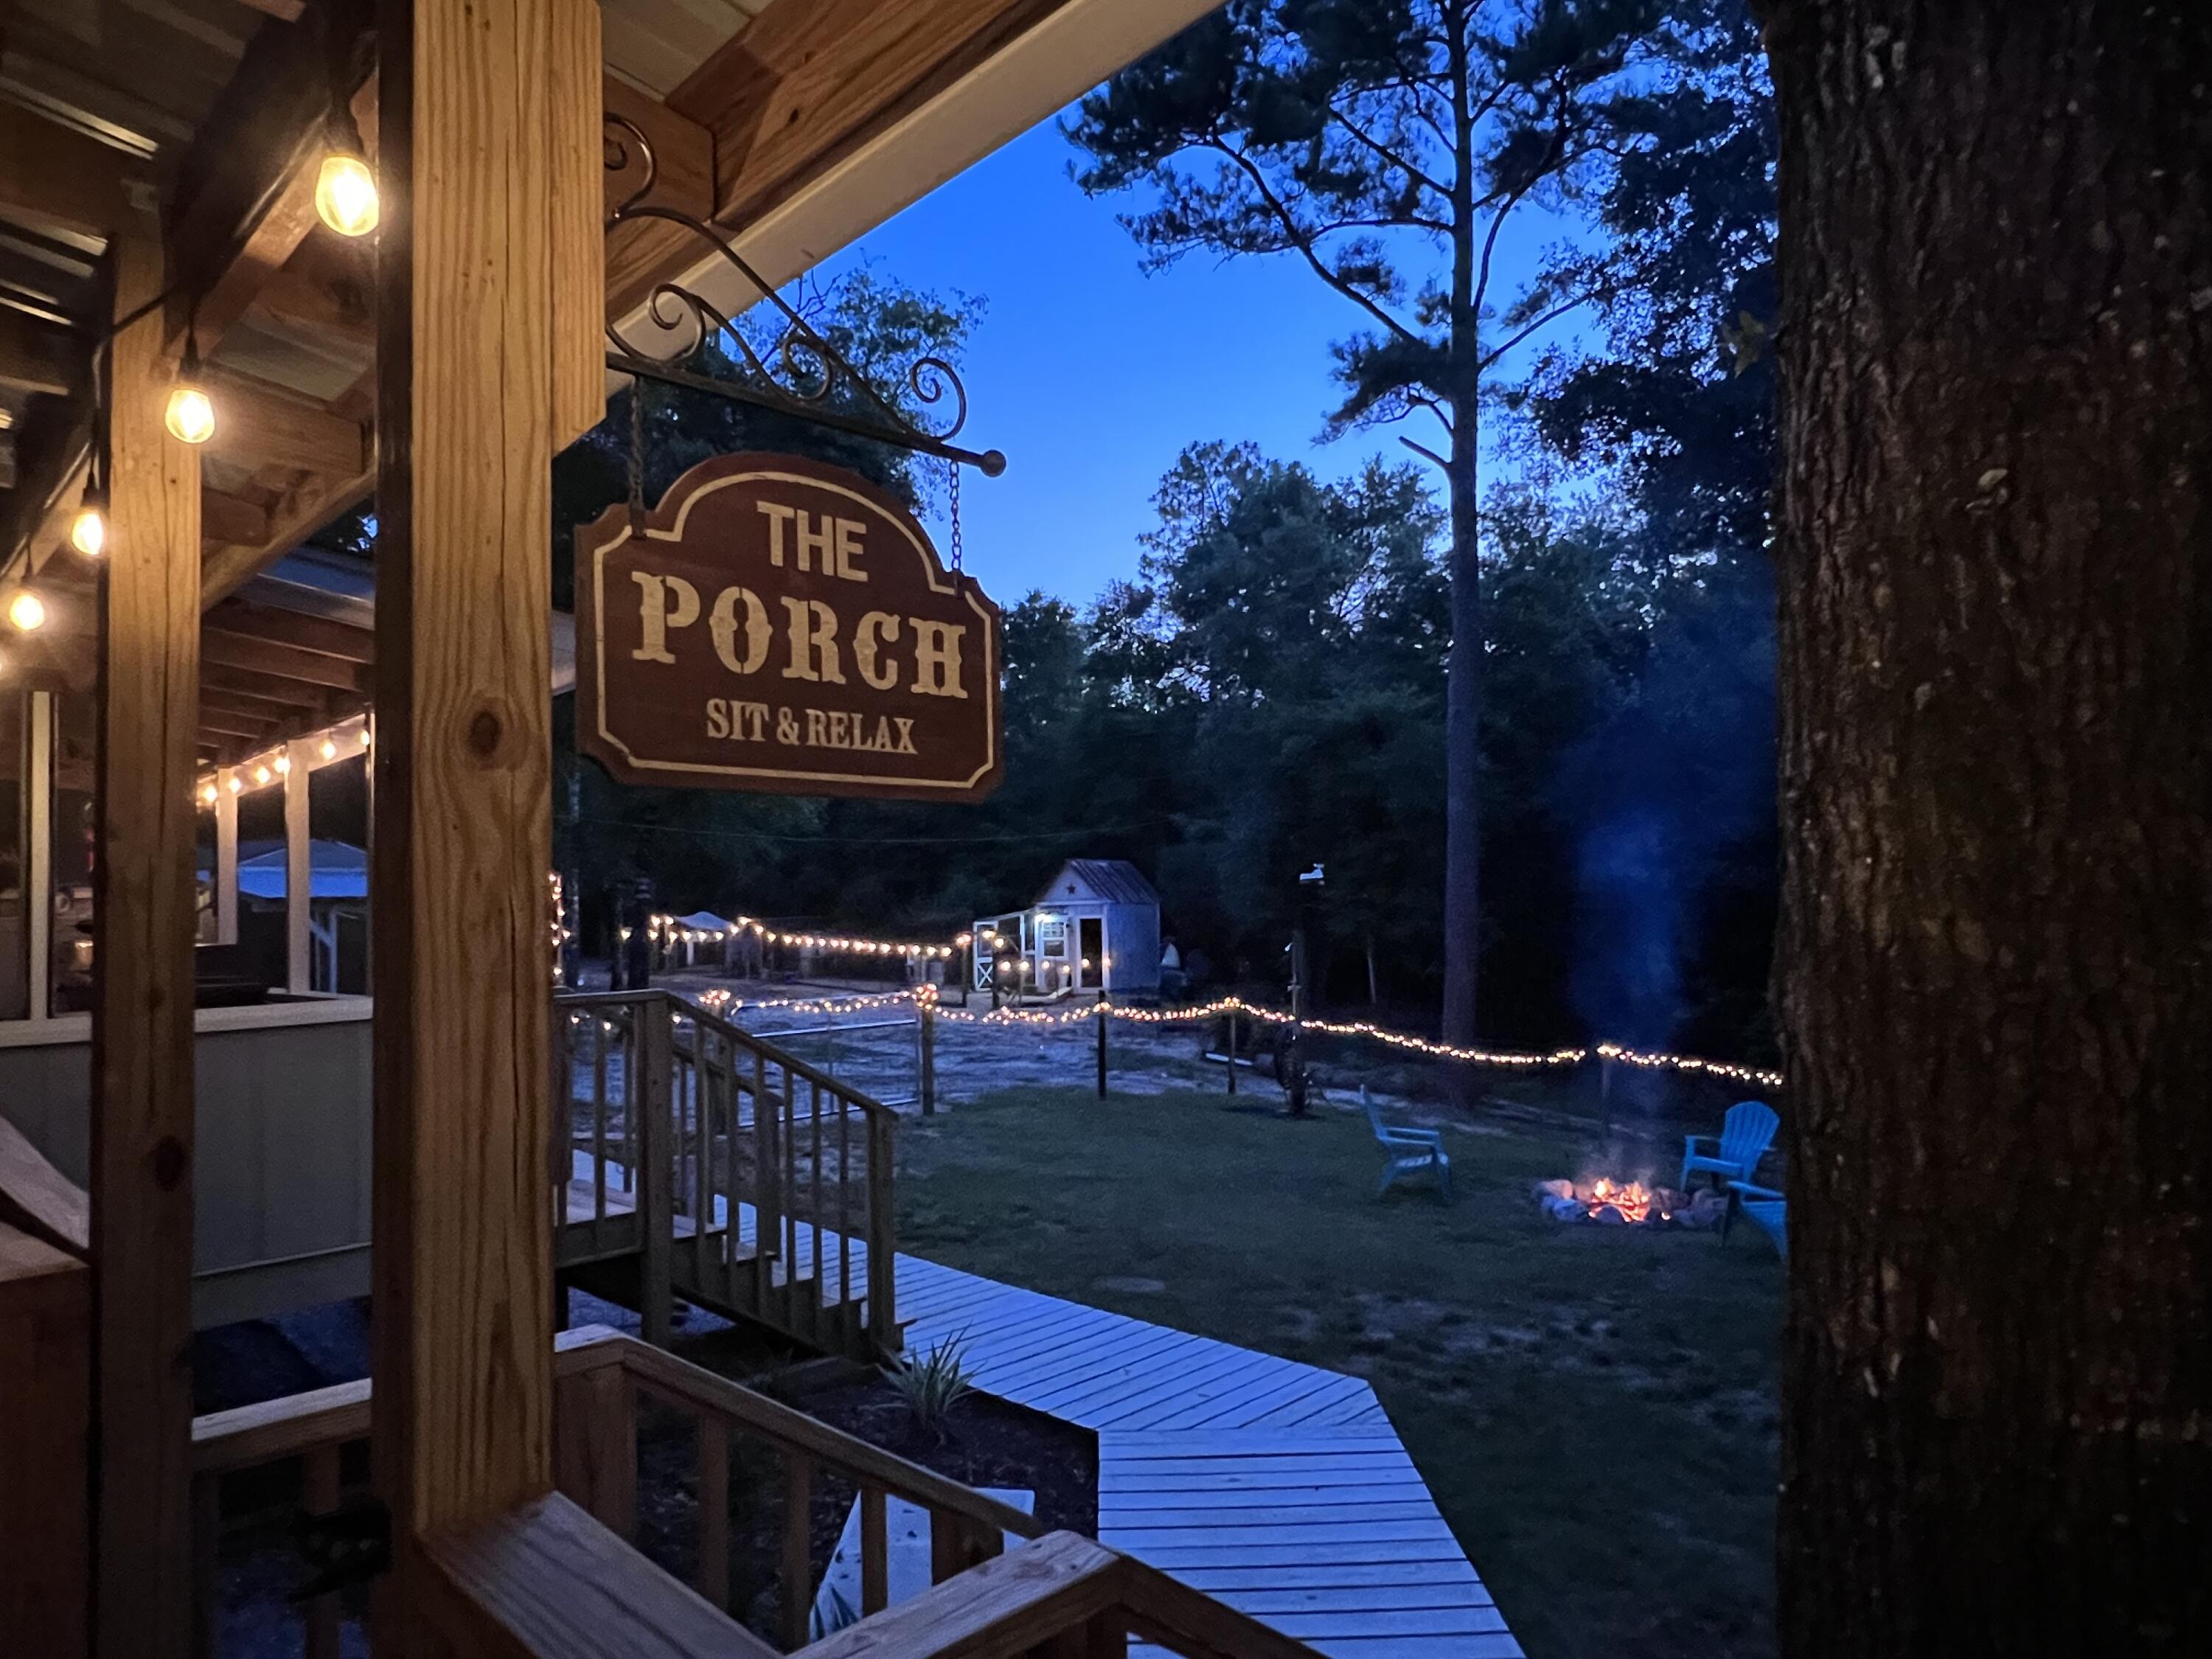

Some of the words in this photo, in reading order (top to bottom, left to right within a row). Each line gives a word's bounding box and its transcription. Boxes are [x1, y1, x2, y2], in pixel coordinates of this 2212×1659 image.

[757, 500, 868, 582] THE
[630, 571, 968, 699] PORCH
[706, 698, 769, 742] SIT
[776, 706, 799, 746] &
[806, 709, 919, 755] RELAX
